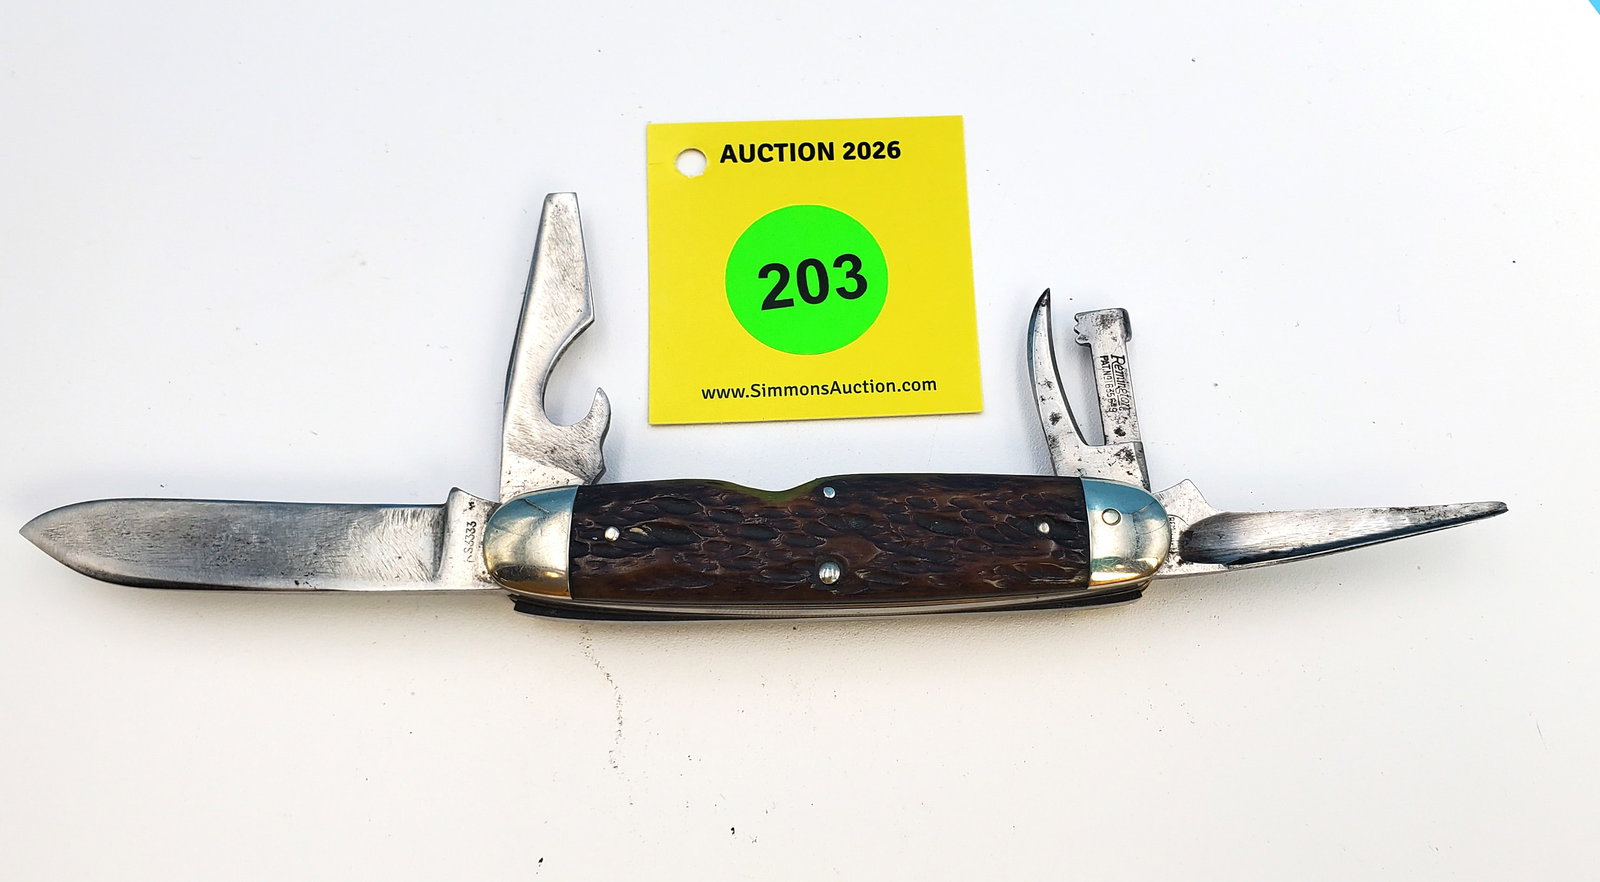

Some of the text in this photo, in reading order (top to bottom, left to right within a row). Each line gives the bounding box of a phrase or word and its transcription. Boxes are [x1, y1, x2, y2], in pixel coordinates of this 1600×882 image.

[720, 141, 901, 163] AUCTION 2026
[758, 253, 868, 311] 203
[701, 379, 937, 400] www.SimmonsAuction.com
[1110, 354, 1131, 415] Remington
